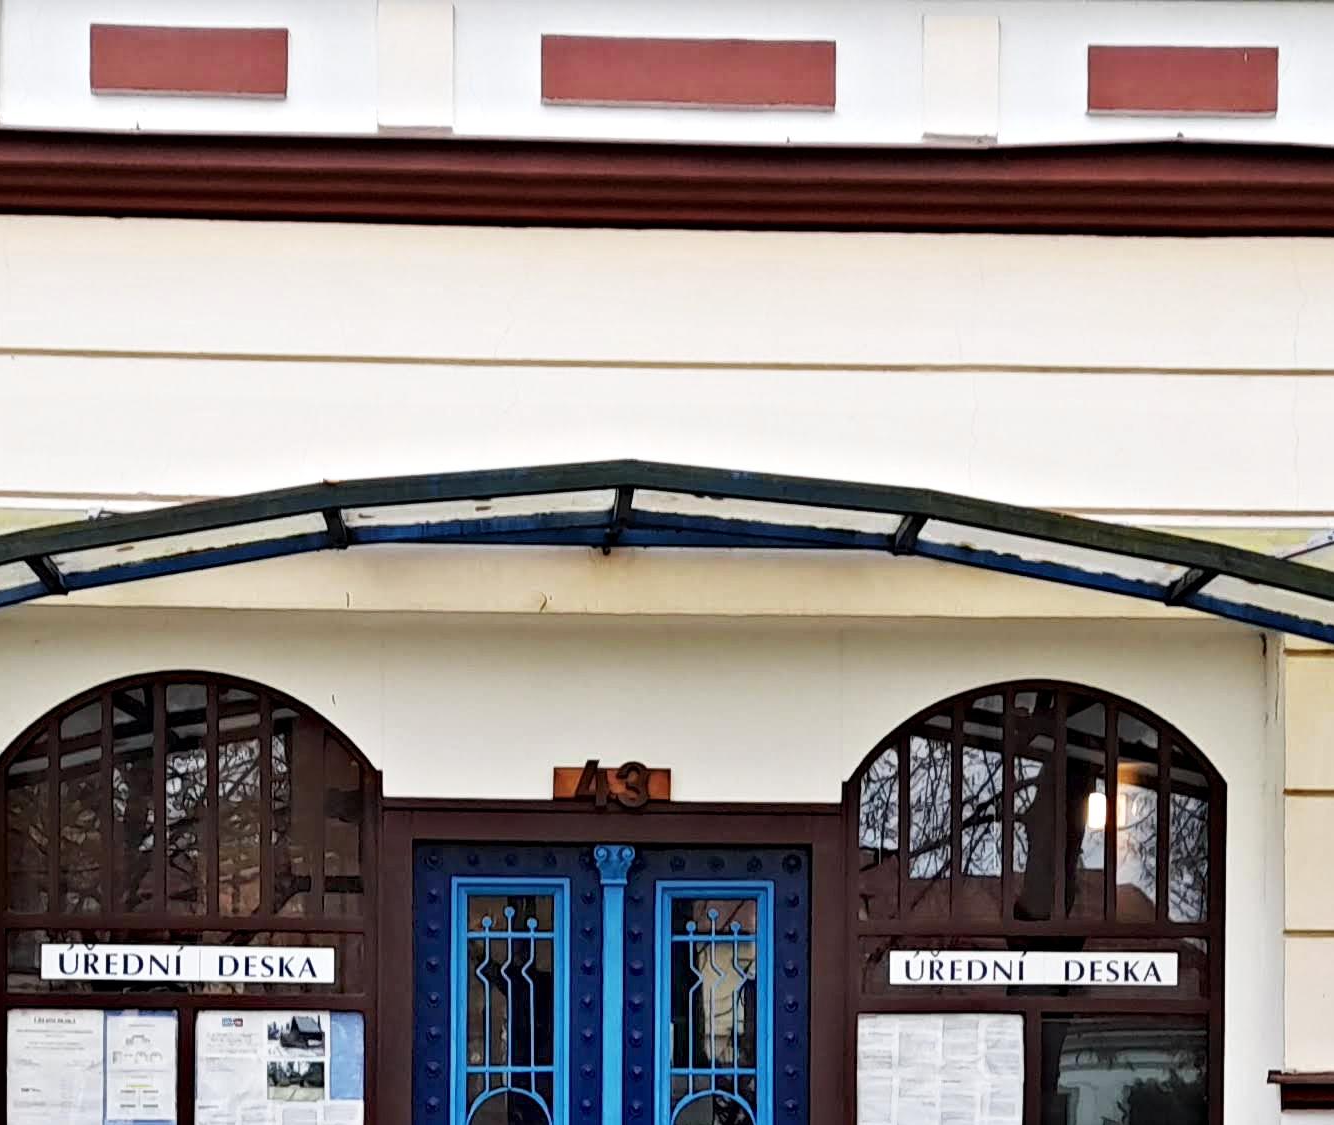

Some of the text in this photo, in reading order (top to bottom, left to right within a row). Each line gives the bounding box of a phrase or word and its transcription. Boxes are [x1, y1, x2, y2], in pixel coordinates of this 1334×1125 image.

[574, 760, 649, 807] 43
[58, 944, 318, 979] ÚŘEDNÍ DESKA
[904, 950, 1162, 983] ÚŘEDNÍ DESKA
